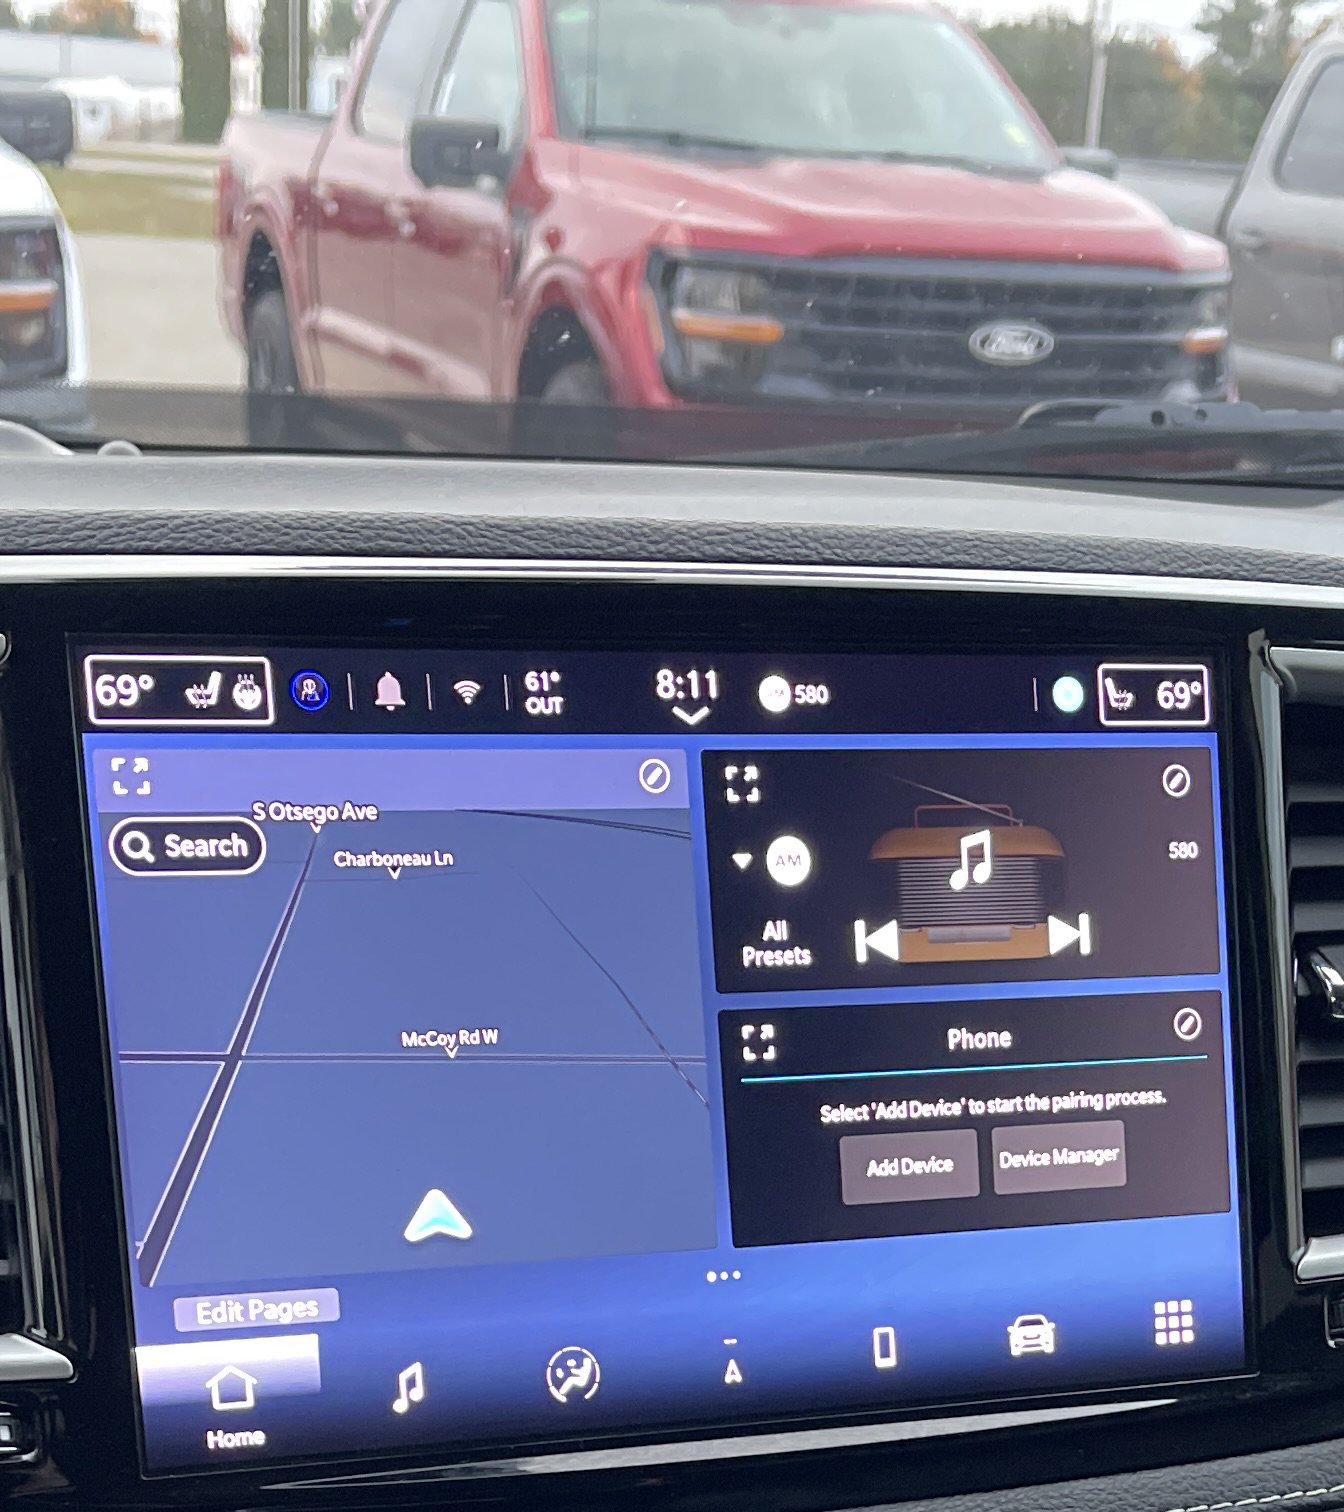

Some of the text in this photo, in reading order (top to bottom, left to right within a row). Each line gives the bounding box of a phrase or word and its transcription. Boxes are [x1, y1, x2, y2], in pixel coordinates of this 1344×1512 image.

[656, 669, 719, 700] 8:11
[794, 683, 830, 704] 580
[525, 695, 564, 716] OUT
[253, 802, 379, 824] S Otsego Ave
[164, 833, 249, 859] Search
[1168, 841, 1199, 860] 580
[333, 850, 454, 868] Charboneau Ln
[774, 853, 802, 869] AM
[762, 920, 788, 943] All
[742, 946, 812, 968] Presets
[401, 1028, 499, 1048] McCoy Rd W
[947, 1028, 1012, 1051] Phone
[819, 1103, 870, 1124] Select
[967, 1099, 985, 1115] to
[987, 1095, 1023, 1114] start
[1025, 1092, 1049, 1111] the
[1052, 1091, 1103, 1113] pairing
[1106, 1090, 1167, 1110] process.
[866, 1156, 955, 1178] Add Device
[999, 1147, 1121, 1169] Device Manager
[196, 1298, 319, 1325] Edit Pages
[206, 1429, 266, 1449] Home
